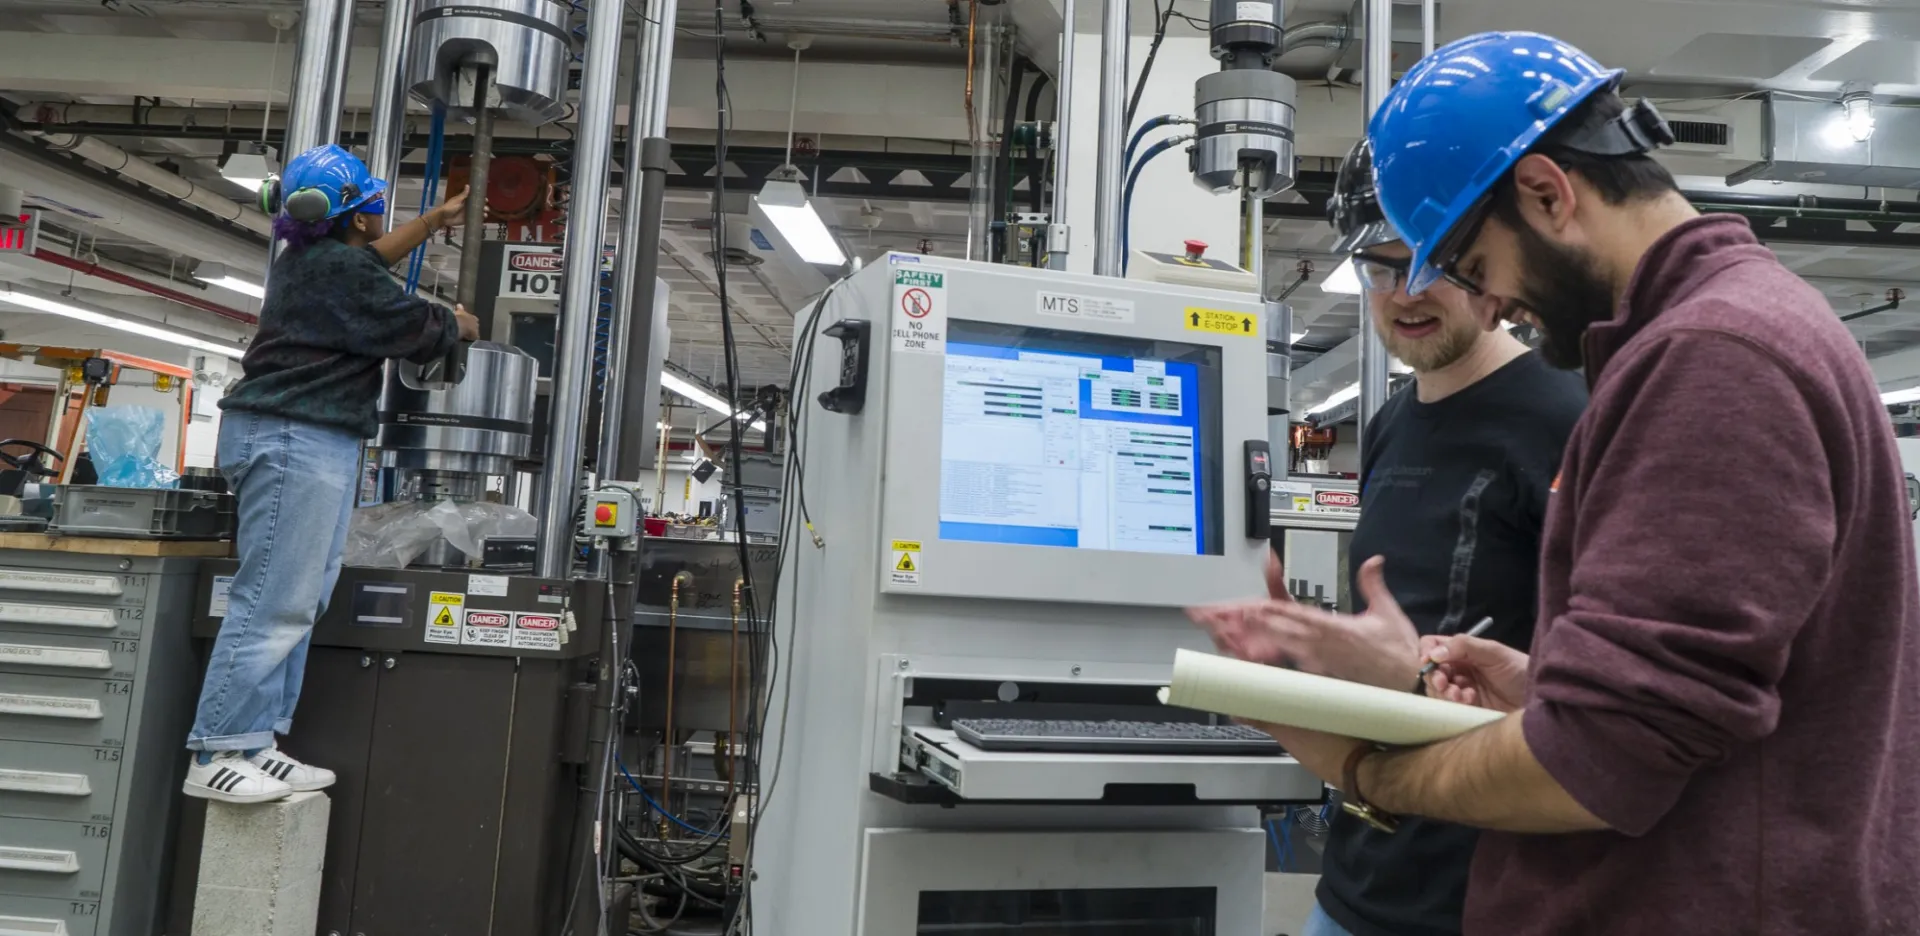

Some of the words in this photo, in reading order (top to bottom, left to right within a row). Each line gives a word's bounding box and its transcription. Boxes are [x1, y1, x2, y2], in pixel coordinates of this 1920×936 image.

[0, 213, 32, 249] IT
[516, 256, 564, 268] DANGE
[896, 269, 940, 283] SAFETY
[904, 279, 931, 287] FIRST
[1043, 296, 1078, 313] MTS
[1204, 312, 1236, 321] STATION
[909, 321, 922, 330] NO
[1204, 320, 1238, 331] E-STOP
[912, 330, 940, 340] PHONE
[904, 340, 926, 348] ZONE
[1320, 494, 1356, 504] DANGER
[124, 576, 146, 586] T1.1
[118, 608, 143, 620] T1.2
[471, 615, 506, 625] DANGER
[520, 618, 556, 628] DANGER
[112, 641, 136, 652] T1.3
[105, 682, 128, 694] T1.4
[94, 749, 119, 761] T1.5
[82, 826, 108, 838] T1.6
[70, 902, 97, 915] T1.7
